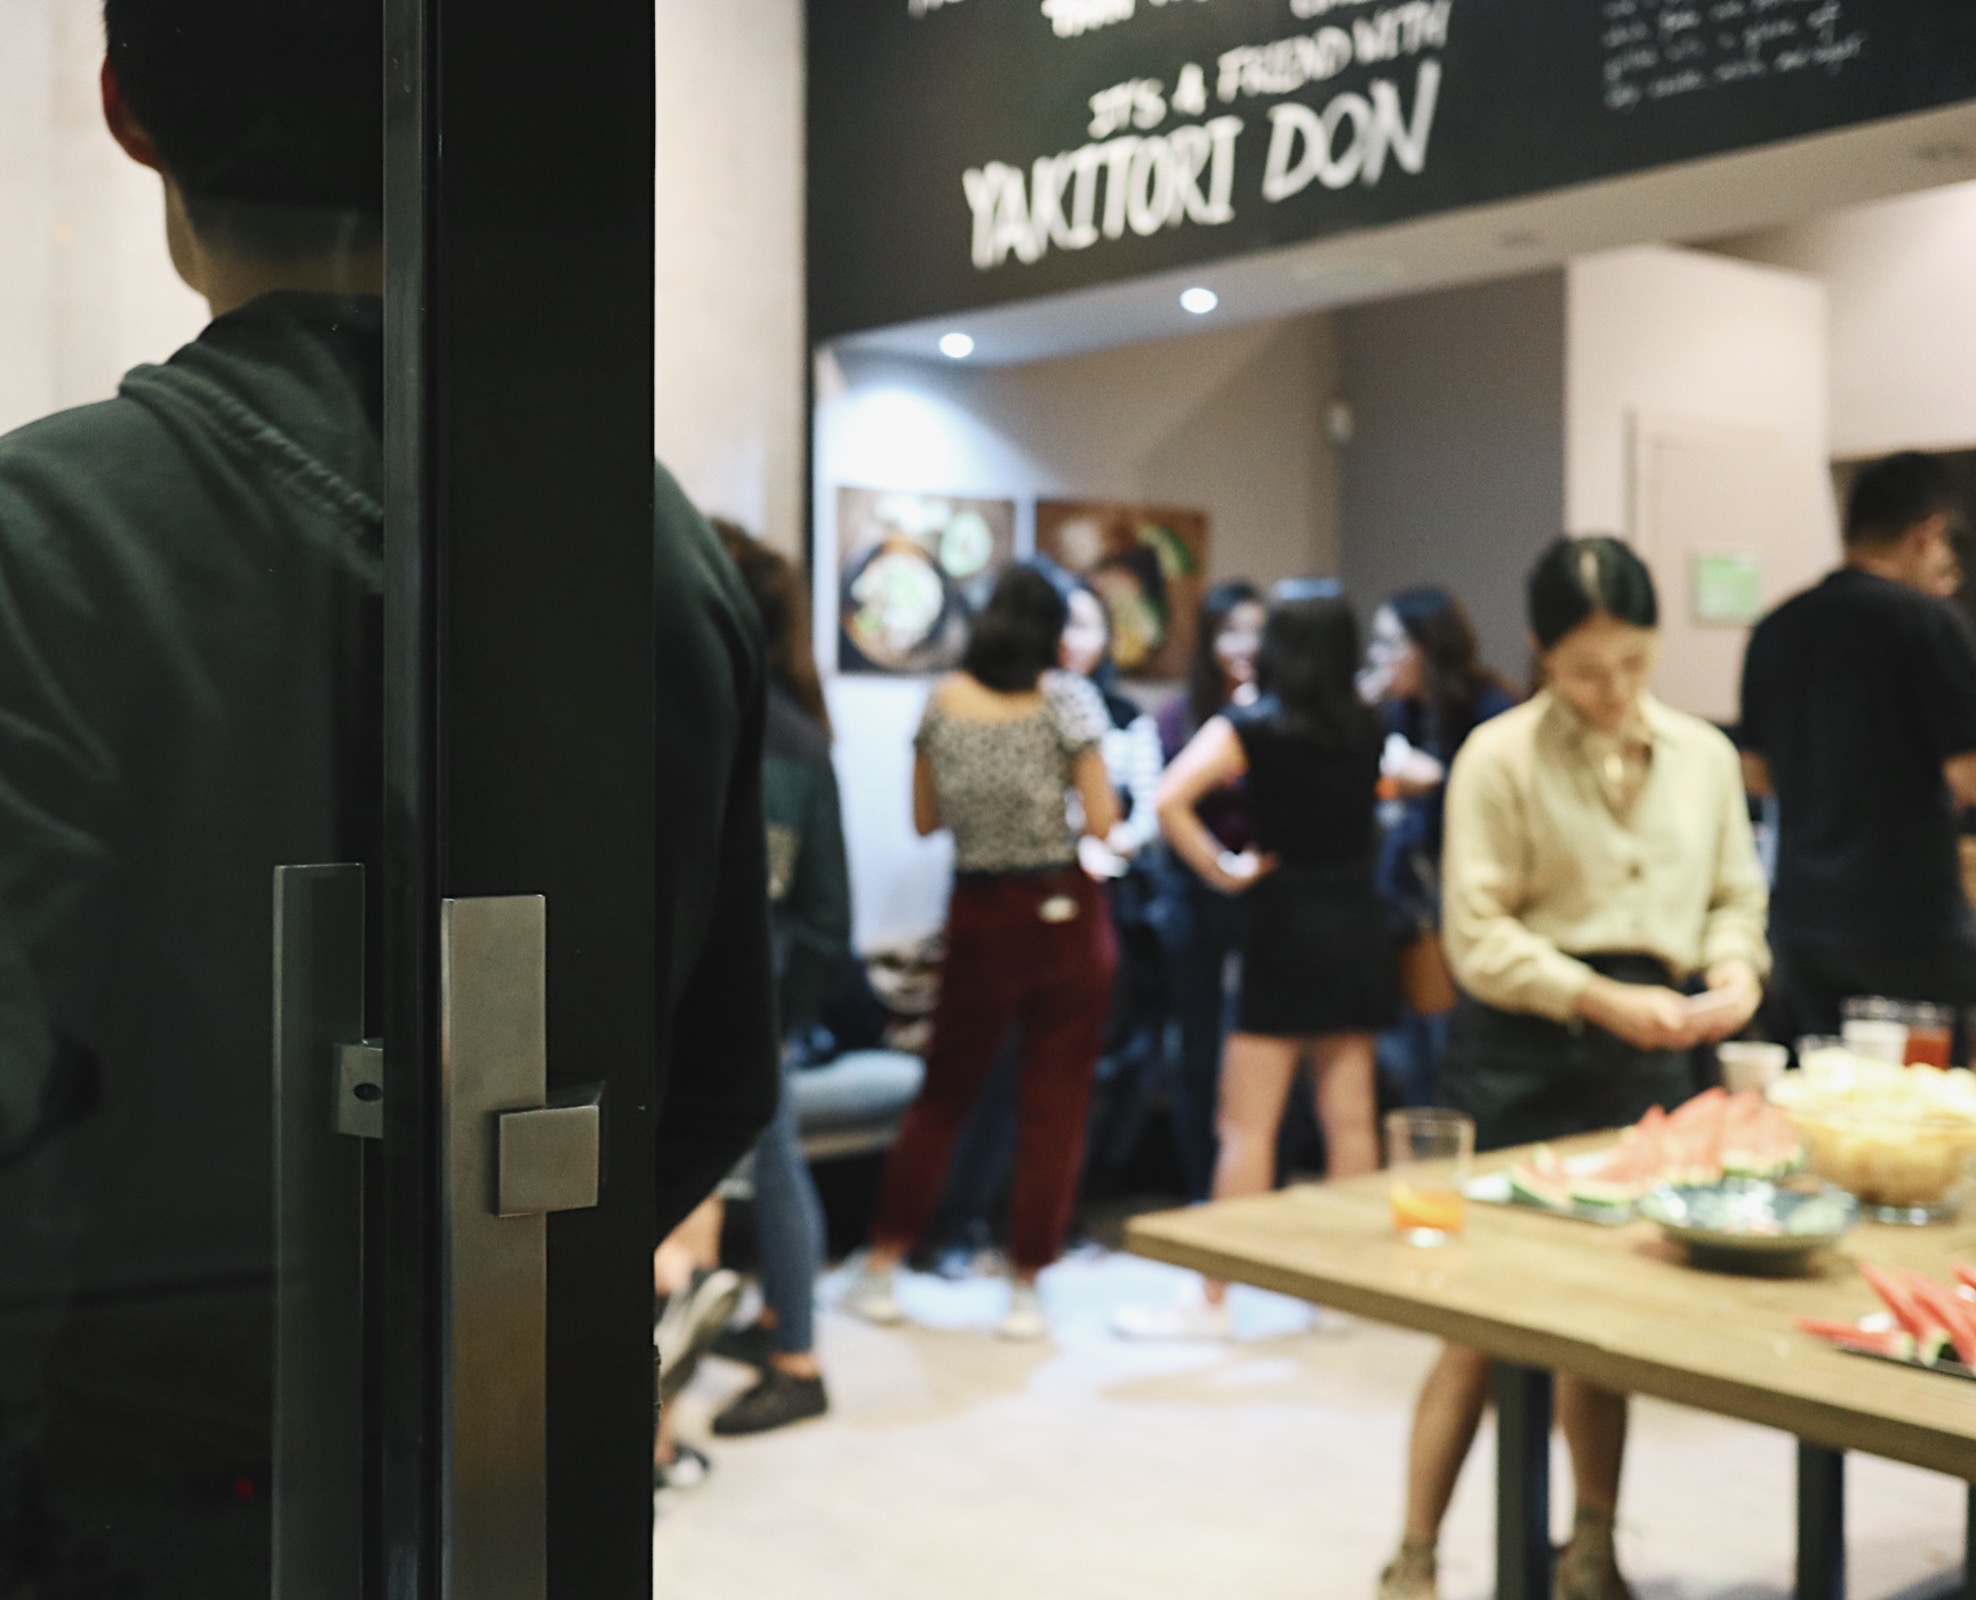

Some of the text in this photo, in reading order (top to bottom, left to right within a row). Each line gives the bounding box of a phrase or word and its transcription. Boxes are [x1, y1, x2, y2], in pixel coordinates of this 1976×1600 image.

[1172, 63, 1206, 115] A
[1217, 26, 1353, 102] FRIEND
[1352, 1, 1449, 64] WITH
[963, 115, 1244, 270] YAKITORI
[1263, 58, 1443, 202] DON
